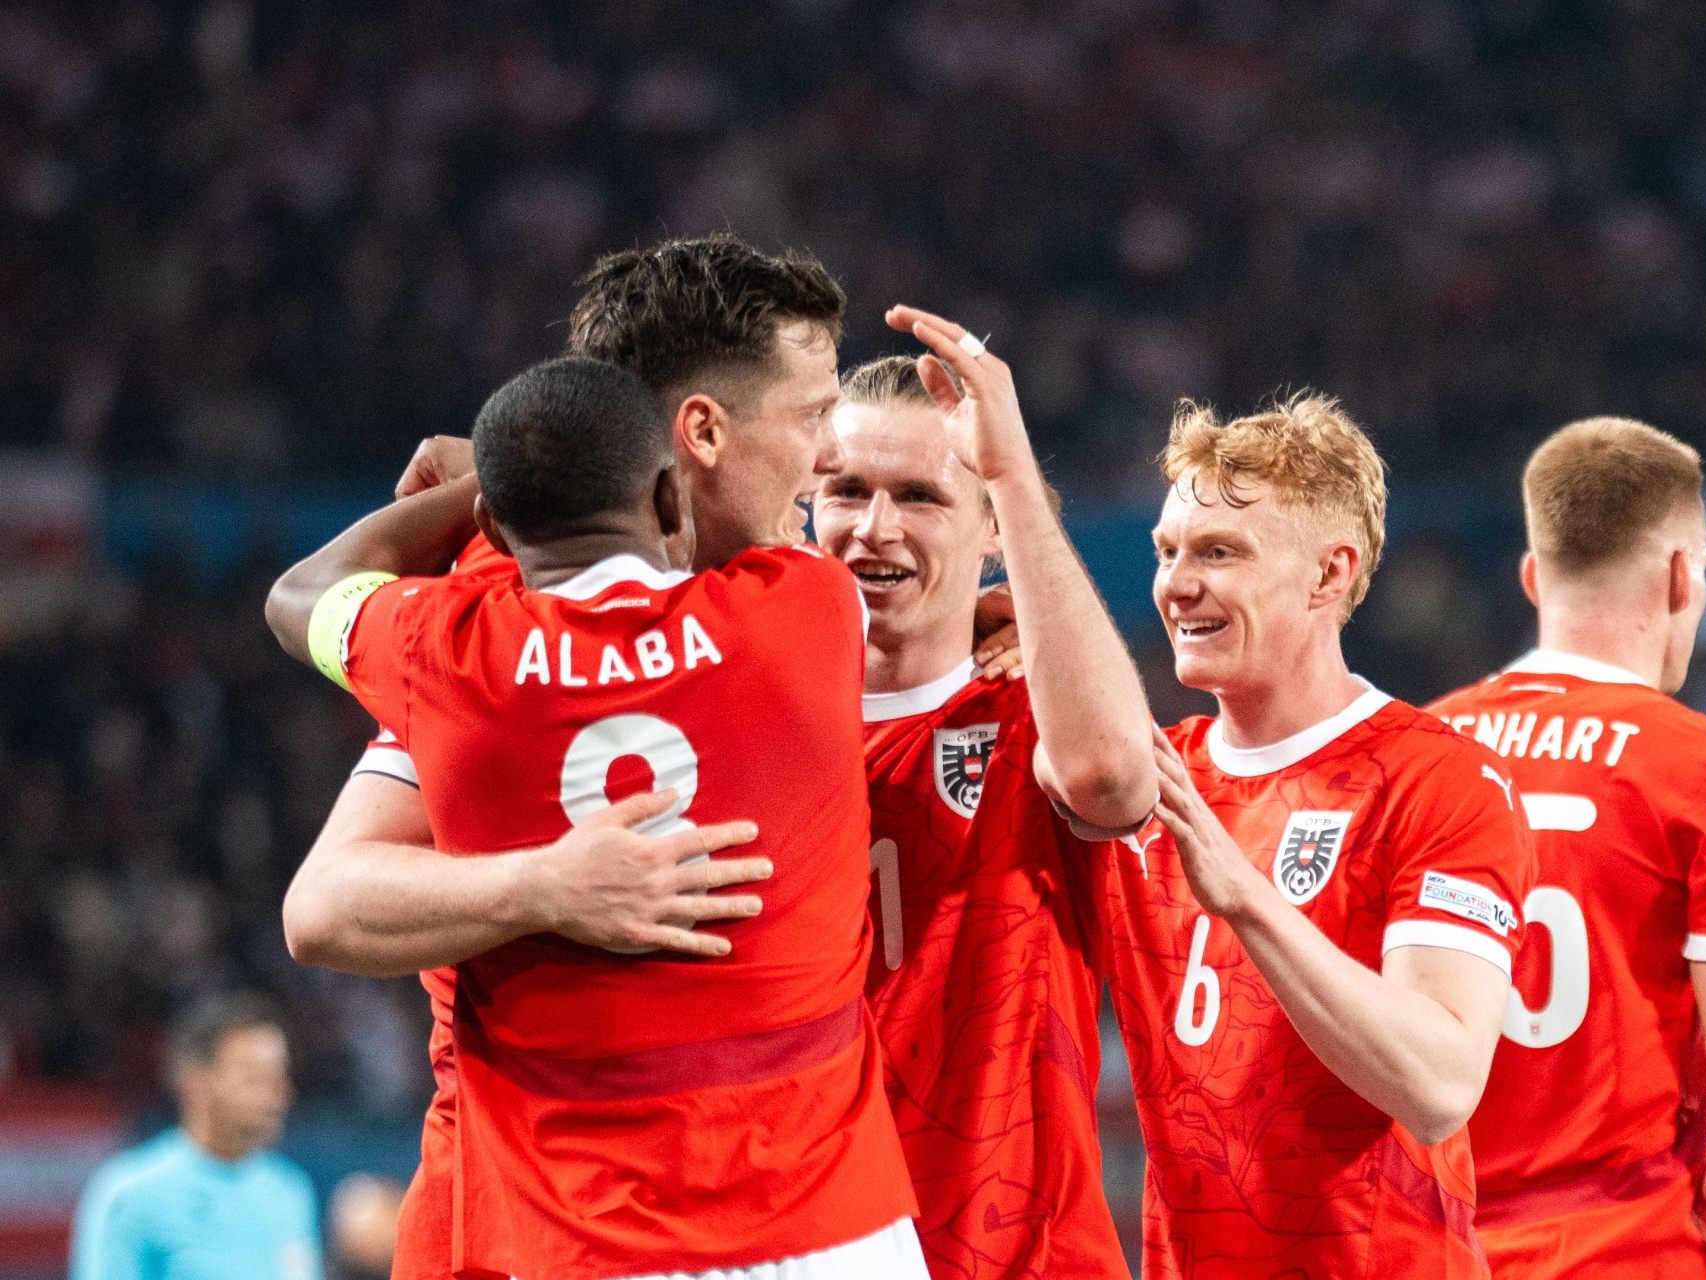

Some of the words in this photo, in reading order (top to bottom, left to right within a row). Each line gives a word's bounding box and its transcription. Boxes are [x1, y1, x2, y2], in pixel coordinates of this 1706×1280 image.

[514, 614, 723, 687] ALABA
[1425, 885, 1492, 912] FOUNDATION
[1175, 914, 1221, 1047] 6
